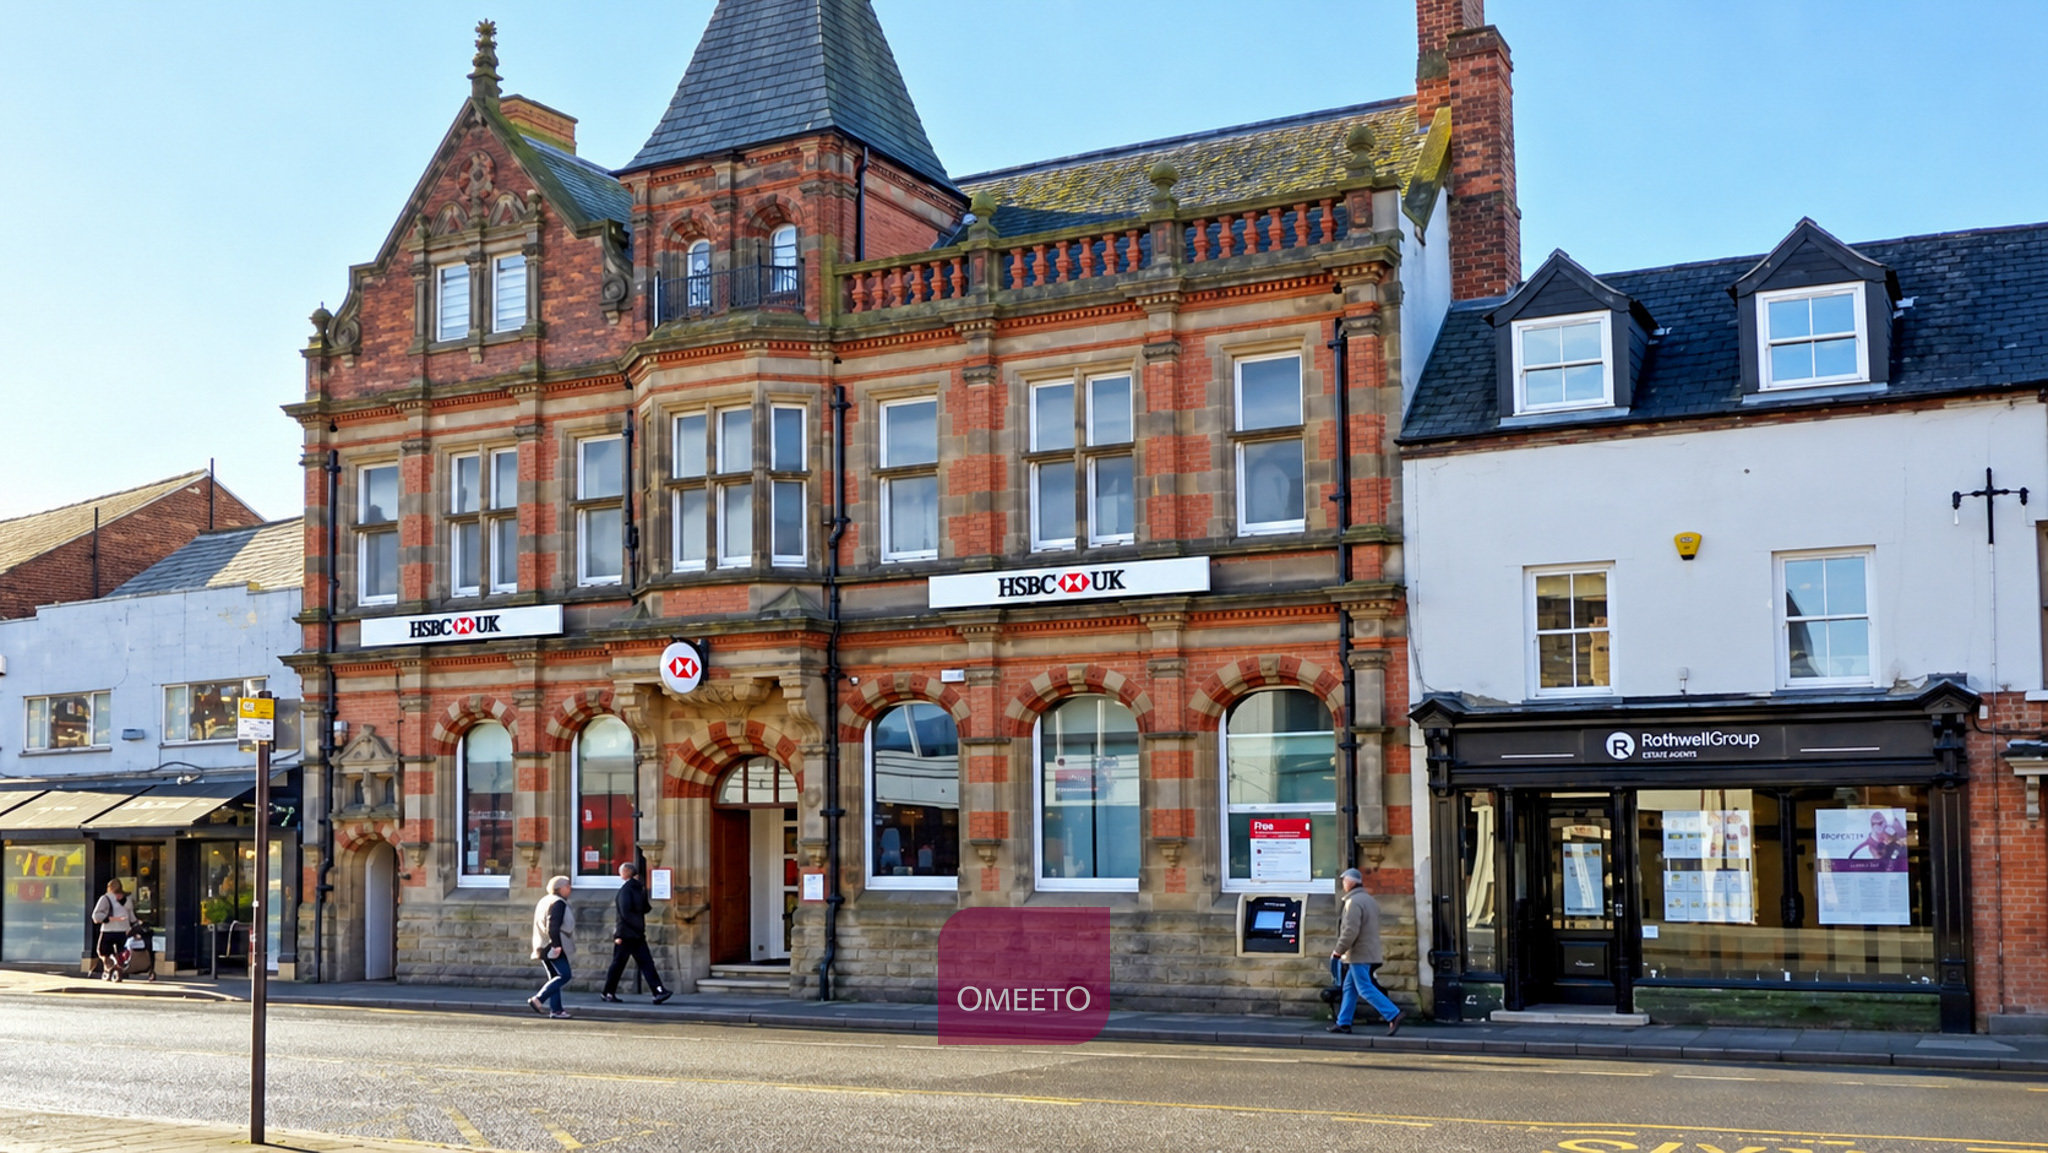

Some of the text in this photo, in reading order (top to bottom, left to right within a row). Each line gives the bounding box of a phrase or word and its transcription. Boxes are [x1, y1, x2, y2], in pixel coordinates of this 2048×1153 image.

[998, 569, 1126, 597] HSBC UK
[409, 615, 501, 638] HSBC UK
[1641, 731, 1760, 749] RothwellGroup
[1668, 750, 1697, 759] AGENTS
[1254, 821, 1274, 831] Free
